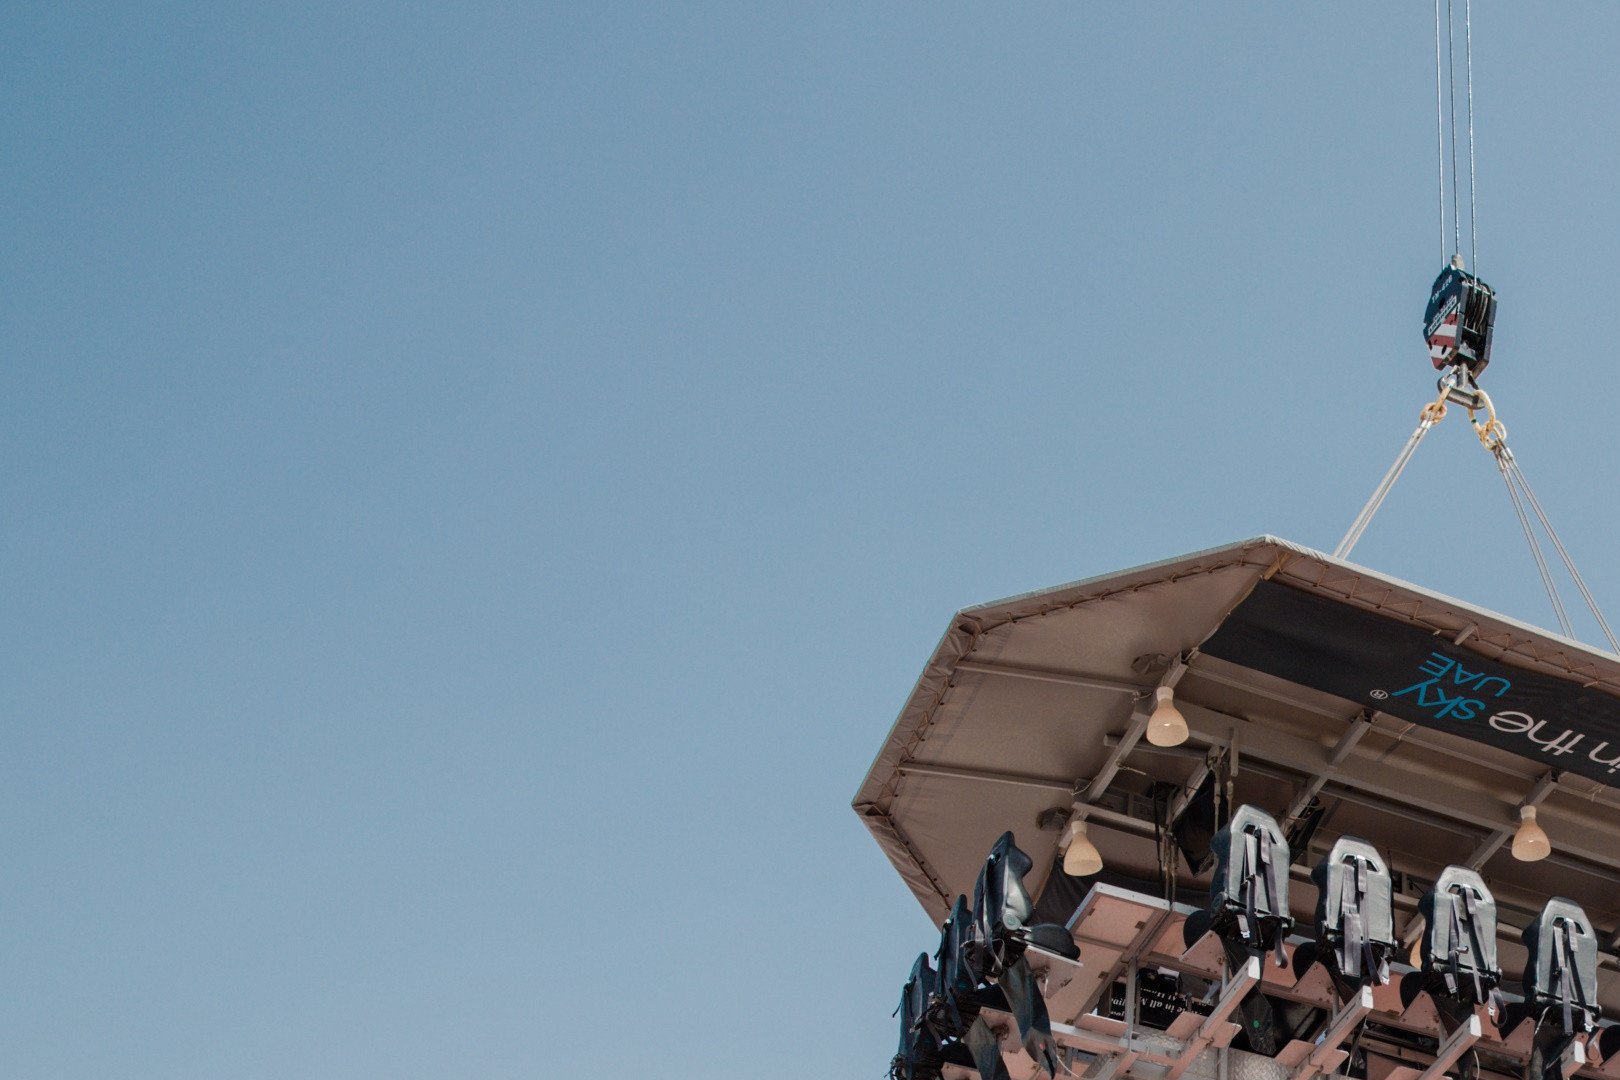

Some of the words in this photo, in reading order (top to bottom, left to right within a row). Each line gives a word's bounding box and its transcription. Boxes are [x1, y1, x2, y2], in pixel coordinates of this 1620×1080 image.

[1418, 651, 1512, 698] UAE
[1391, 677, 1486, 720] sky
[1488, 710, 1586, 756] the
